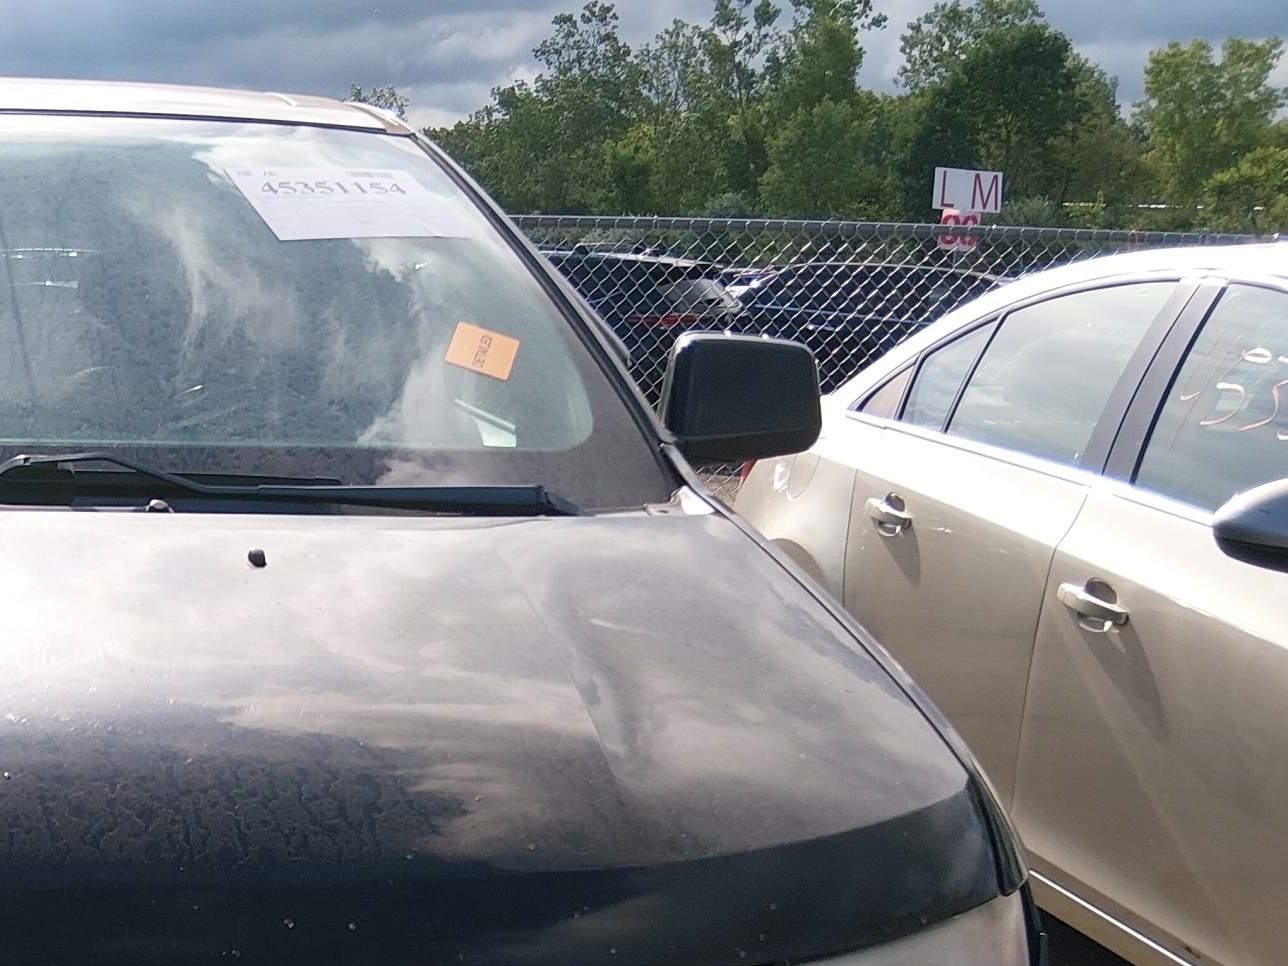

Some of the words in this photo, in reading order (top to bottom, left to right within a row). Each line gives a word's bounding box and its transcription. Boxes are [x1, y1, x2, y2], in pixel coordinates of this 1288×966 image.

[260, 180, 407, 196] 45351154
[940, 170, 954, 207] L
[971, 173, 999, 211] M
